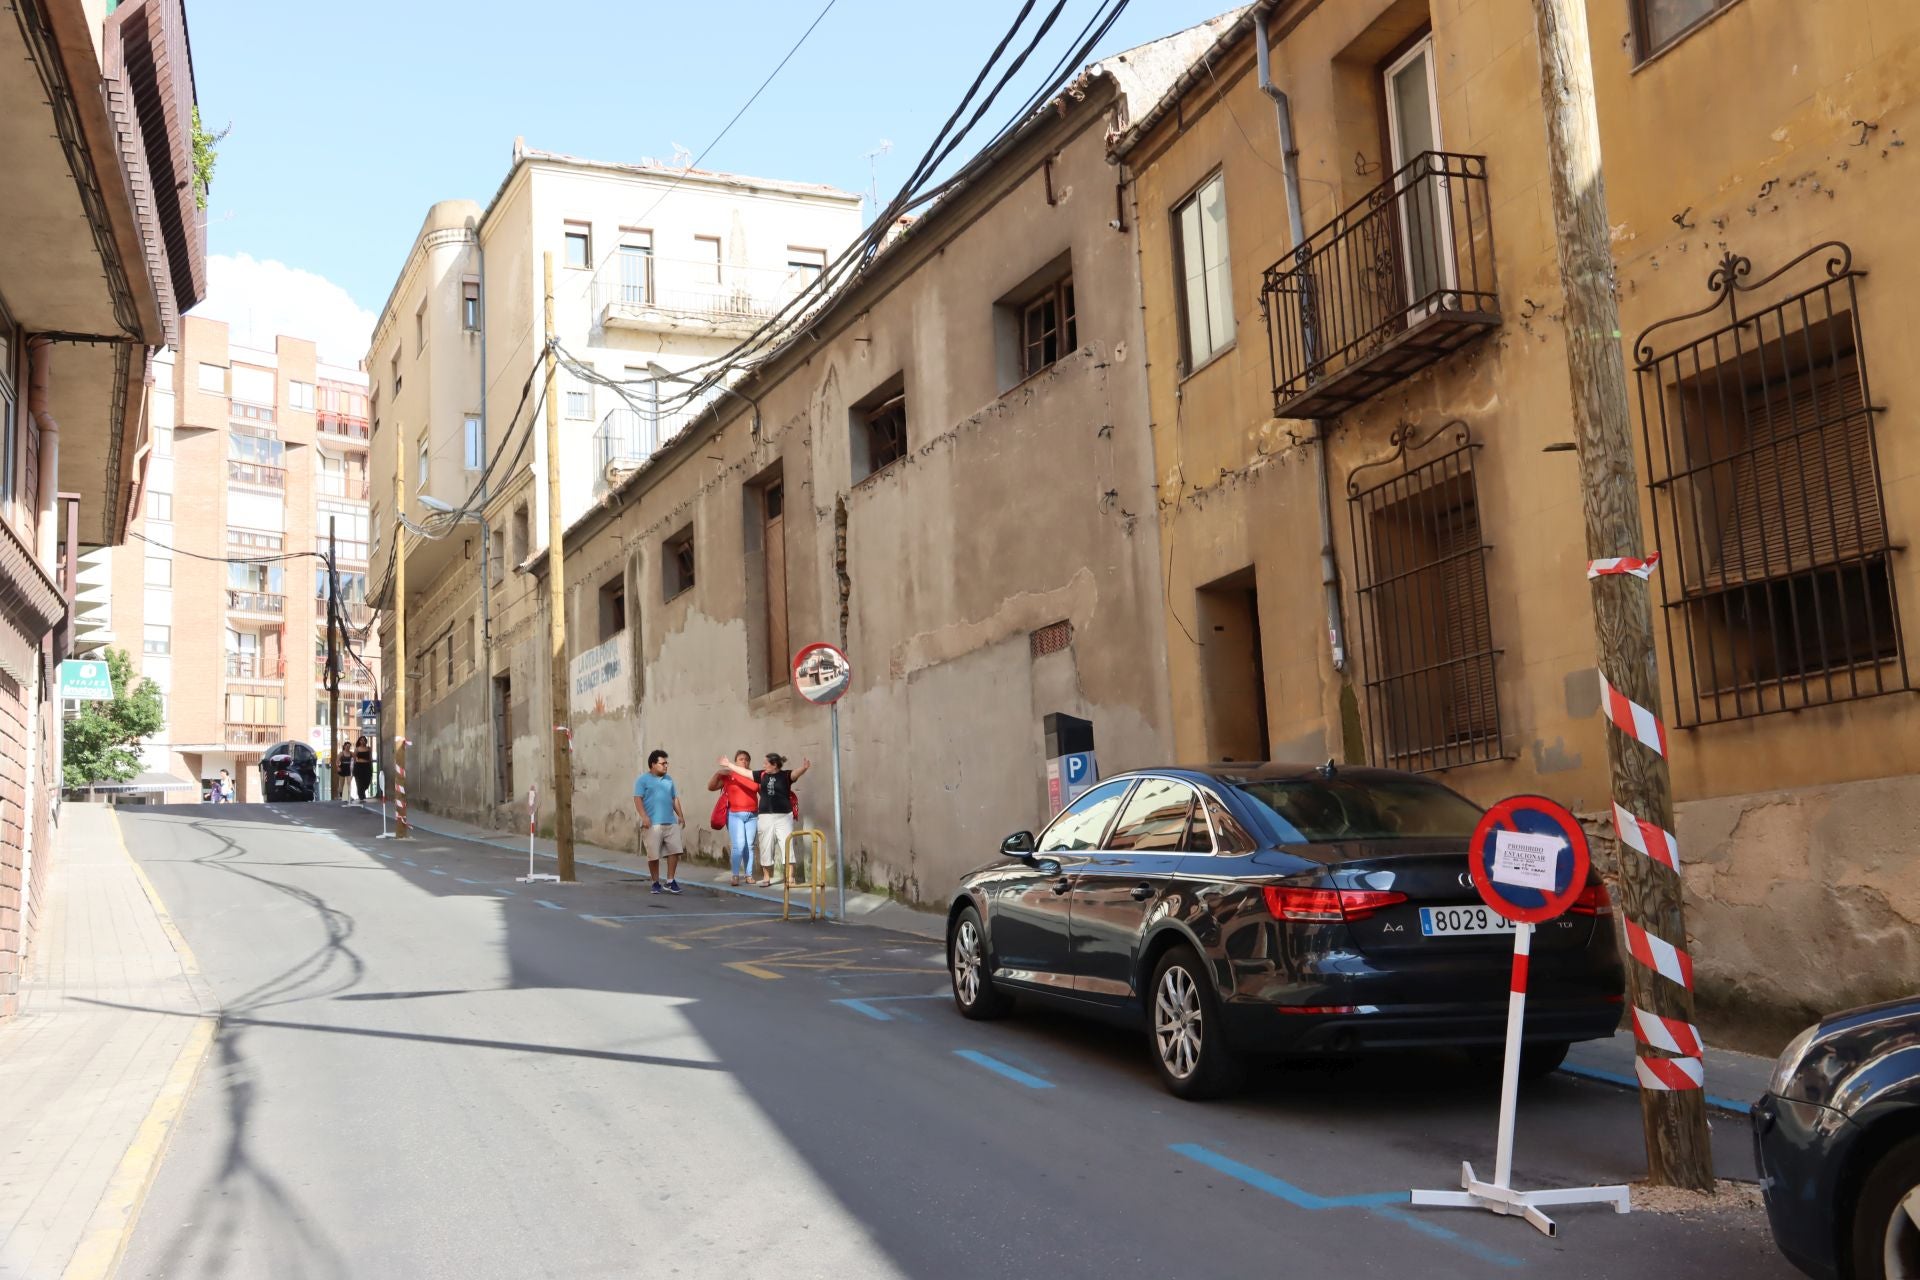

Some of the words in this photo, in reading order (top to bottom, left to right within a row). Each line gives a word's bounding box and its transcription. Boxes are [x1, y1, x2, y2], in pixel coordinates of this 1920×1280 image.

[69, 679, 106, 687] VIAJES
[1069, 757, 1082, 778] P
[1507, 843, 1544, 853] PROHIBIDO
[1503, 850, 1546, 861] ESTACIONAR
[1435, 908, 1488, 931] 8029
[1382, 923, 1404, 933] A4
